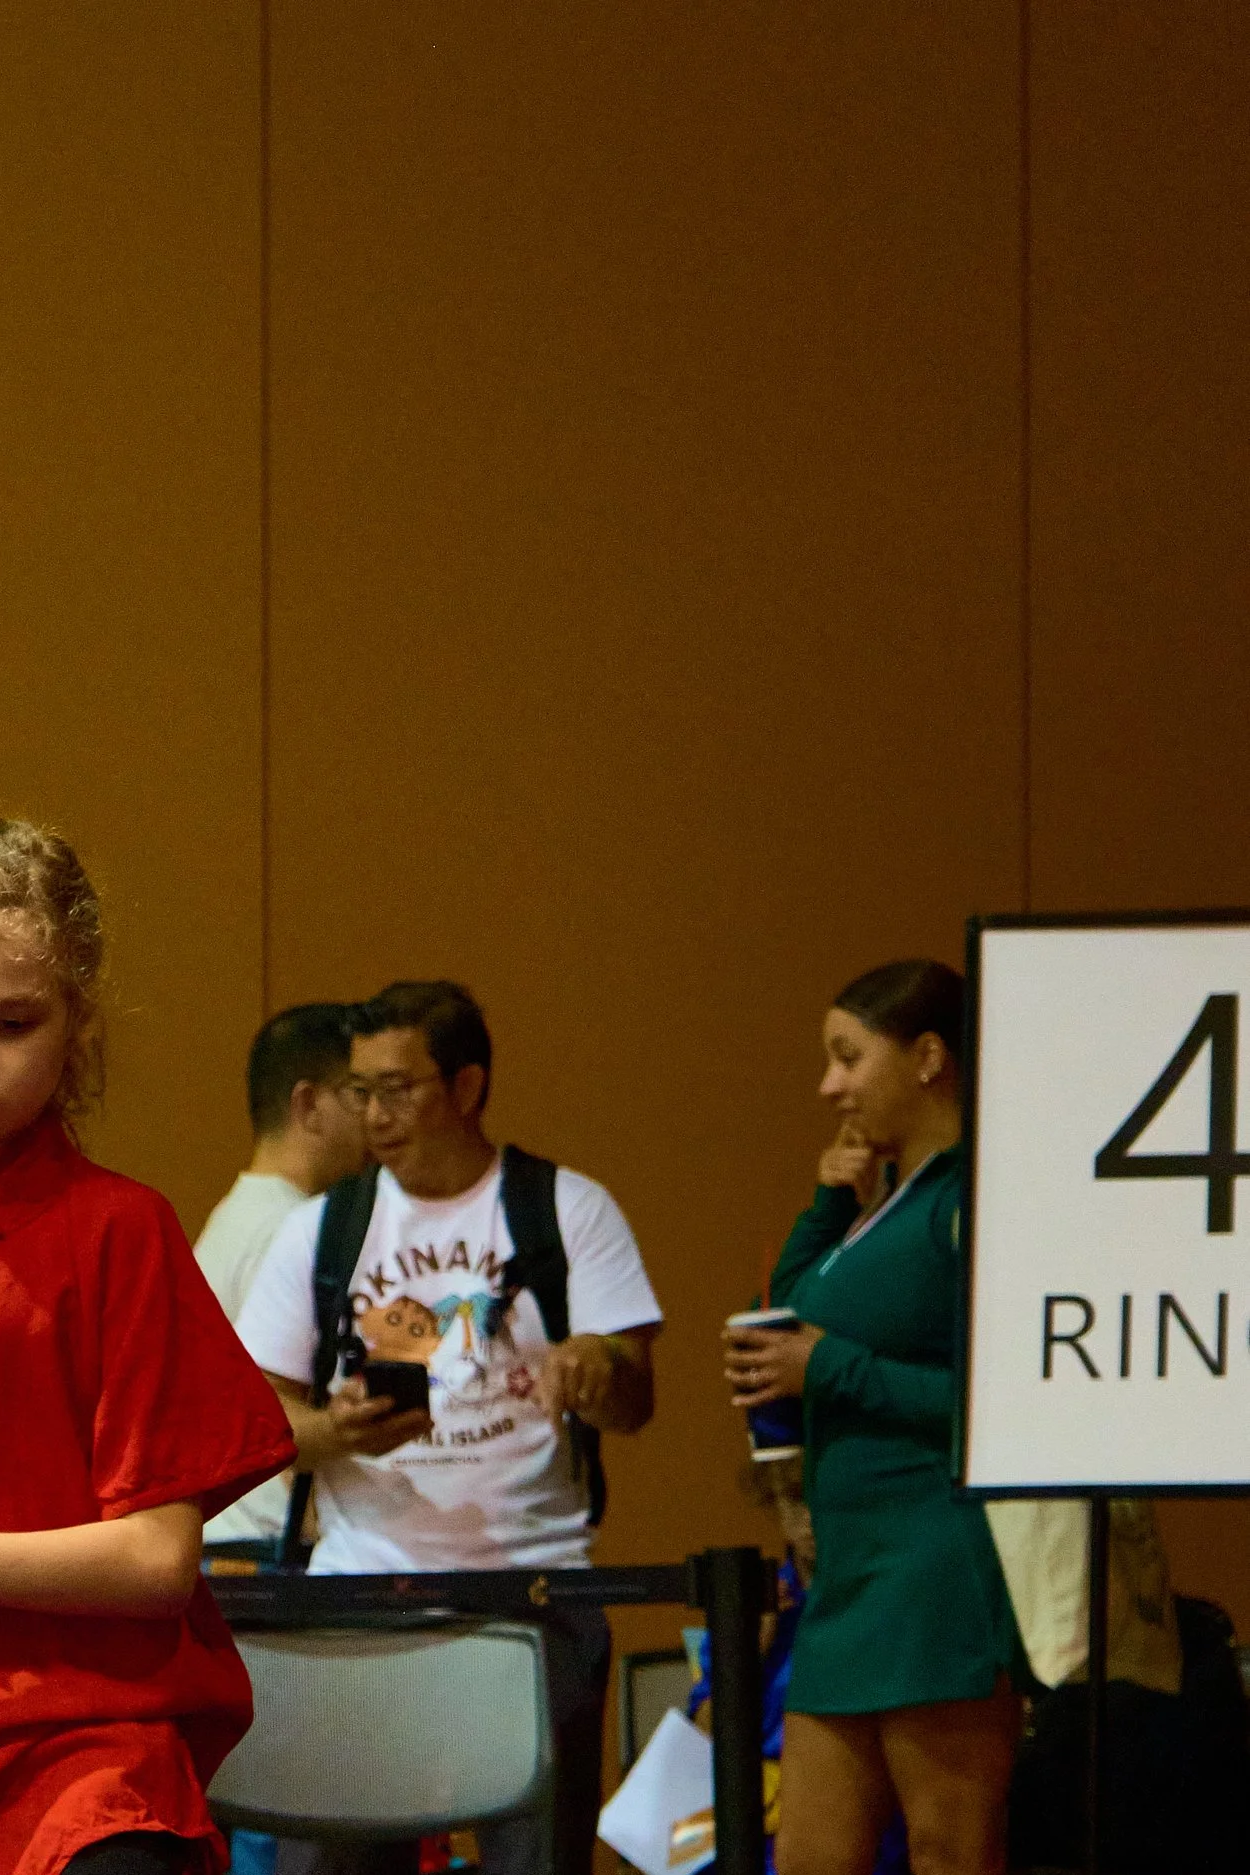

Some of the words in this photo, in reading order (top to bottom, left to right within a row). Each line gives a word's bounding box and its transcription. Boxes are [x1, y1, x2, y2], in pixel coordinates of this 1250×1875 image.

[1092, 992, 1250, 1235] 4
[348, 1239, 507, 1319] OKINAW
[1041, 1291, 1250, 1382] RIN
